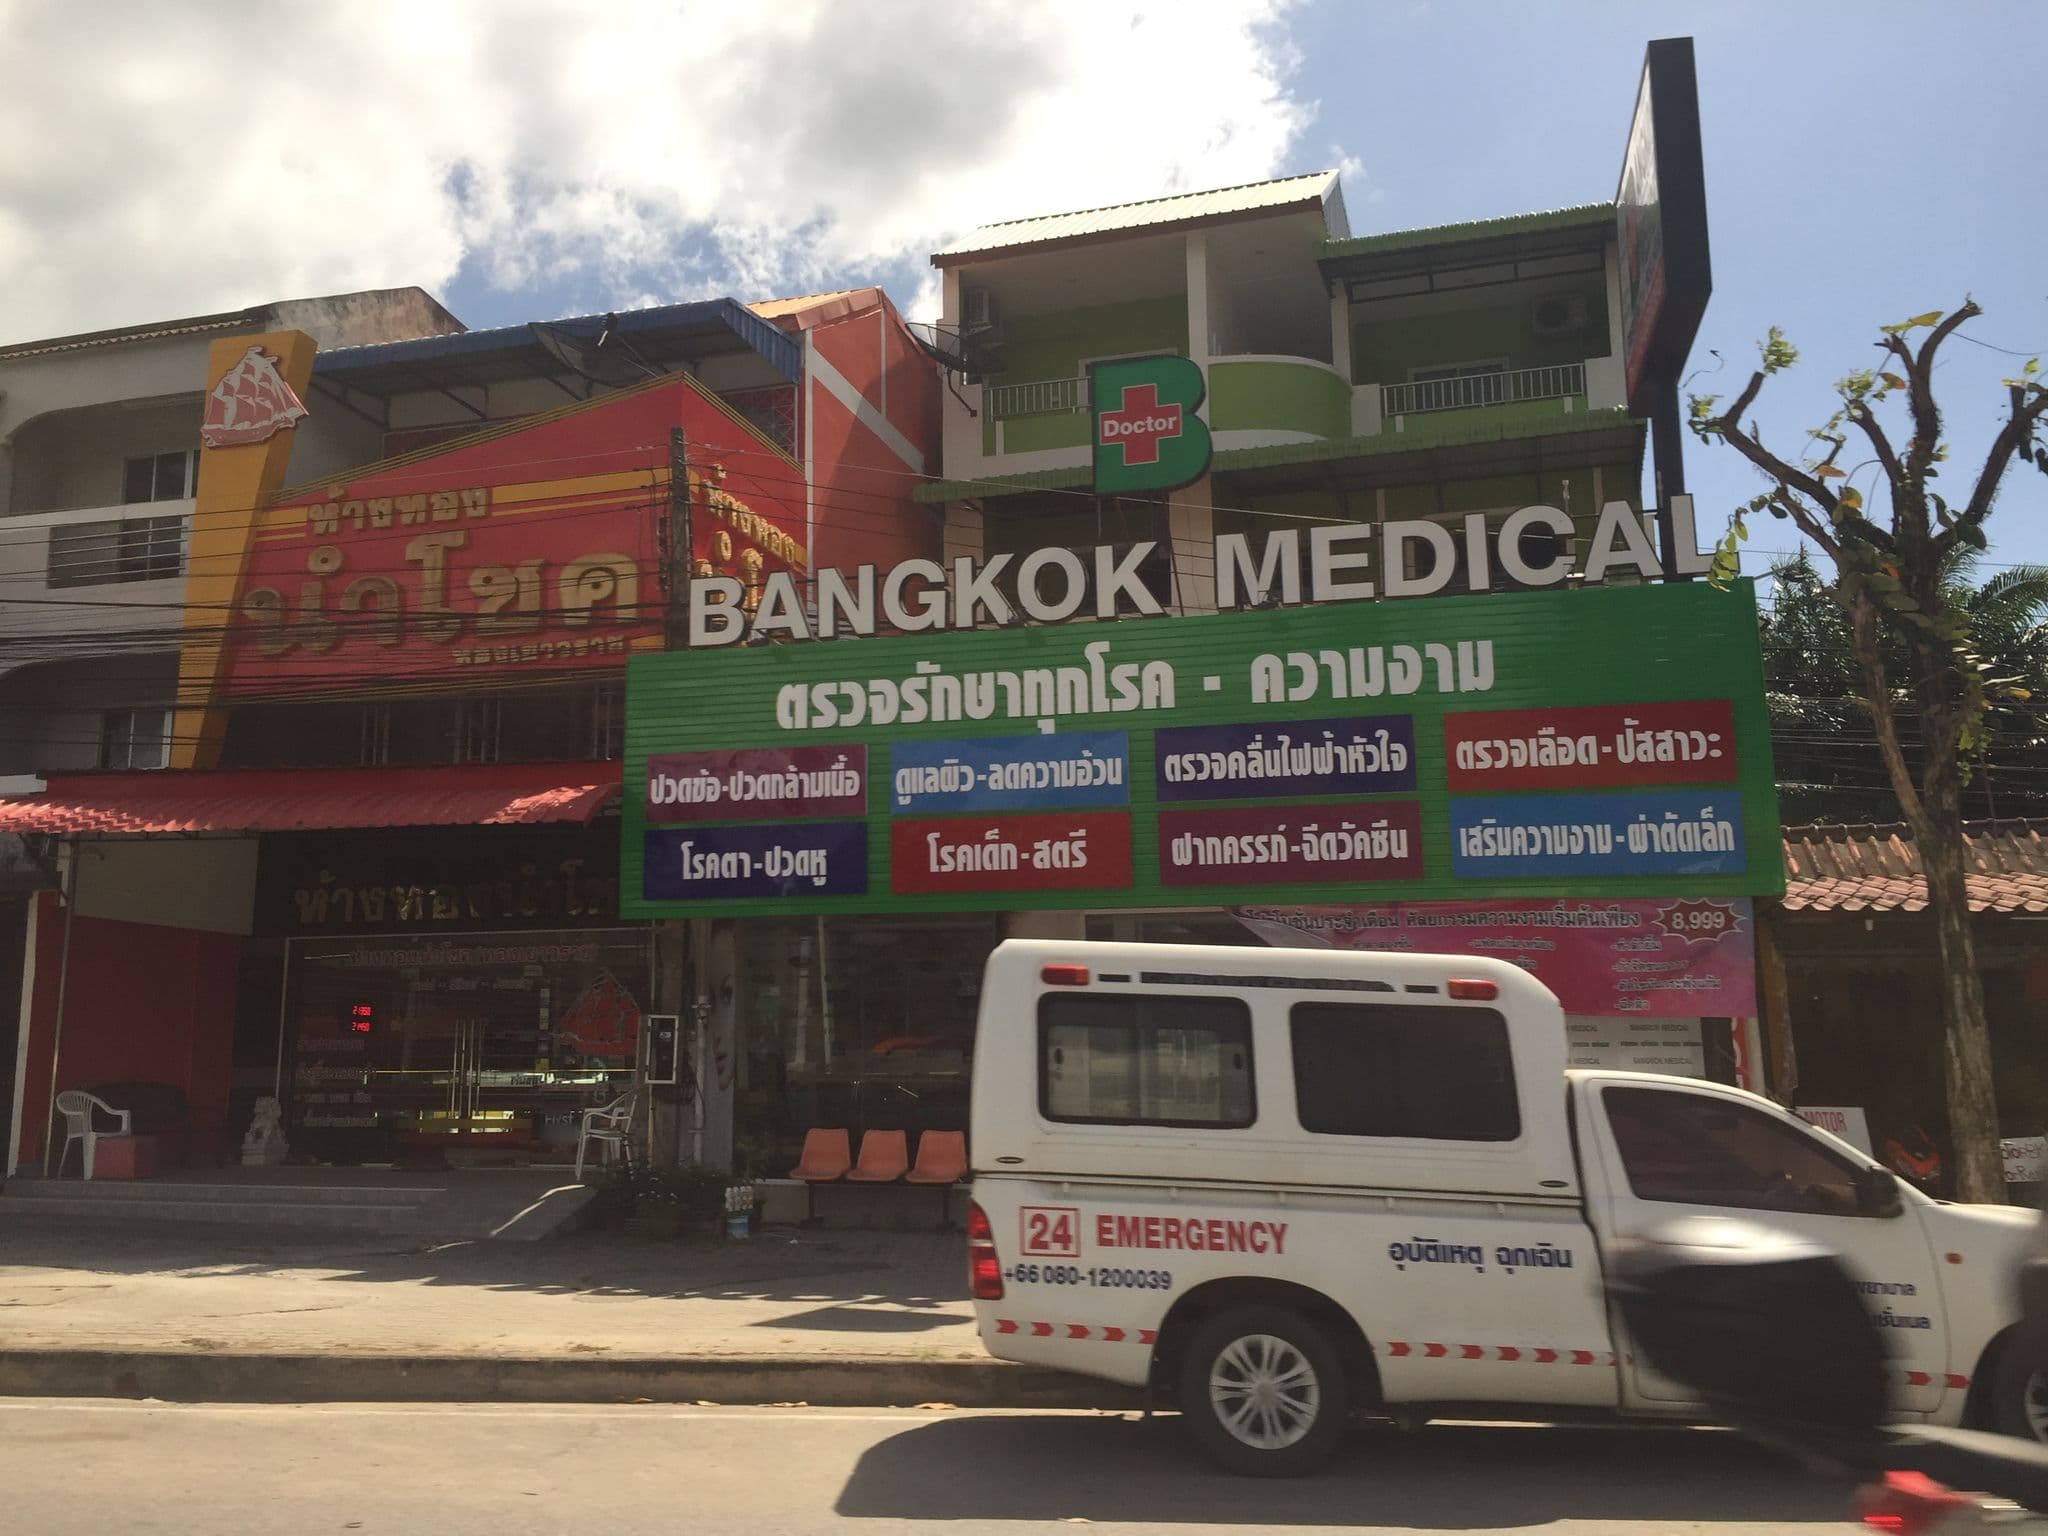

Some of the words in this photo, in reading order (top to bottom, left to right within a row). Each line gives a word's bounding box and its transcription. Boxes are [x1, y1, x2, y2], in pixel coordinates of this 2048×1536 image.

[1102, 416, 1178, 438] Doctor
[307, 485, 488, 535] ห้างทอง
[241, 529, 642, 656] นำโชค
[688, 541, 1170, 649] BANGKOK
[1215, 493, 1741, 609] MEDICAL
[776, 641, 1176, 735] ตรวจรักษาทุกโรค
[1250, 640, 1495, 703] ความงาม
[650, 754, 861, 804] ปวดข้อ-ปวดกล้ามเนื้อ
[895, 749, 1123, 806] ดูแลผิว-ลดความอ้วน
[1164, 729, 1409, 783] ตรวจคลื่นไฟฟ้าหัวใจ
[1671, 910, 1726, 931] 8,999
[1028, 1213, 1073, 1251] 24
[1096, 1214, 1289, 1254] EMERGENCY
[1388, 1236, 1486, 1274] อุบัติเหตุ
[1496, 1242, 1574, 1275] ฉุกเฉิน
[1042, 1264, 1172, 1290] 080-1200039
